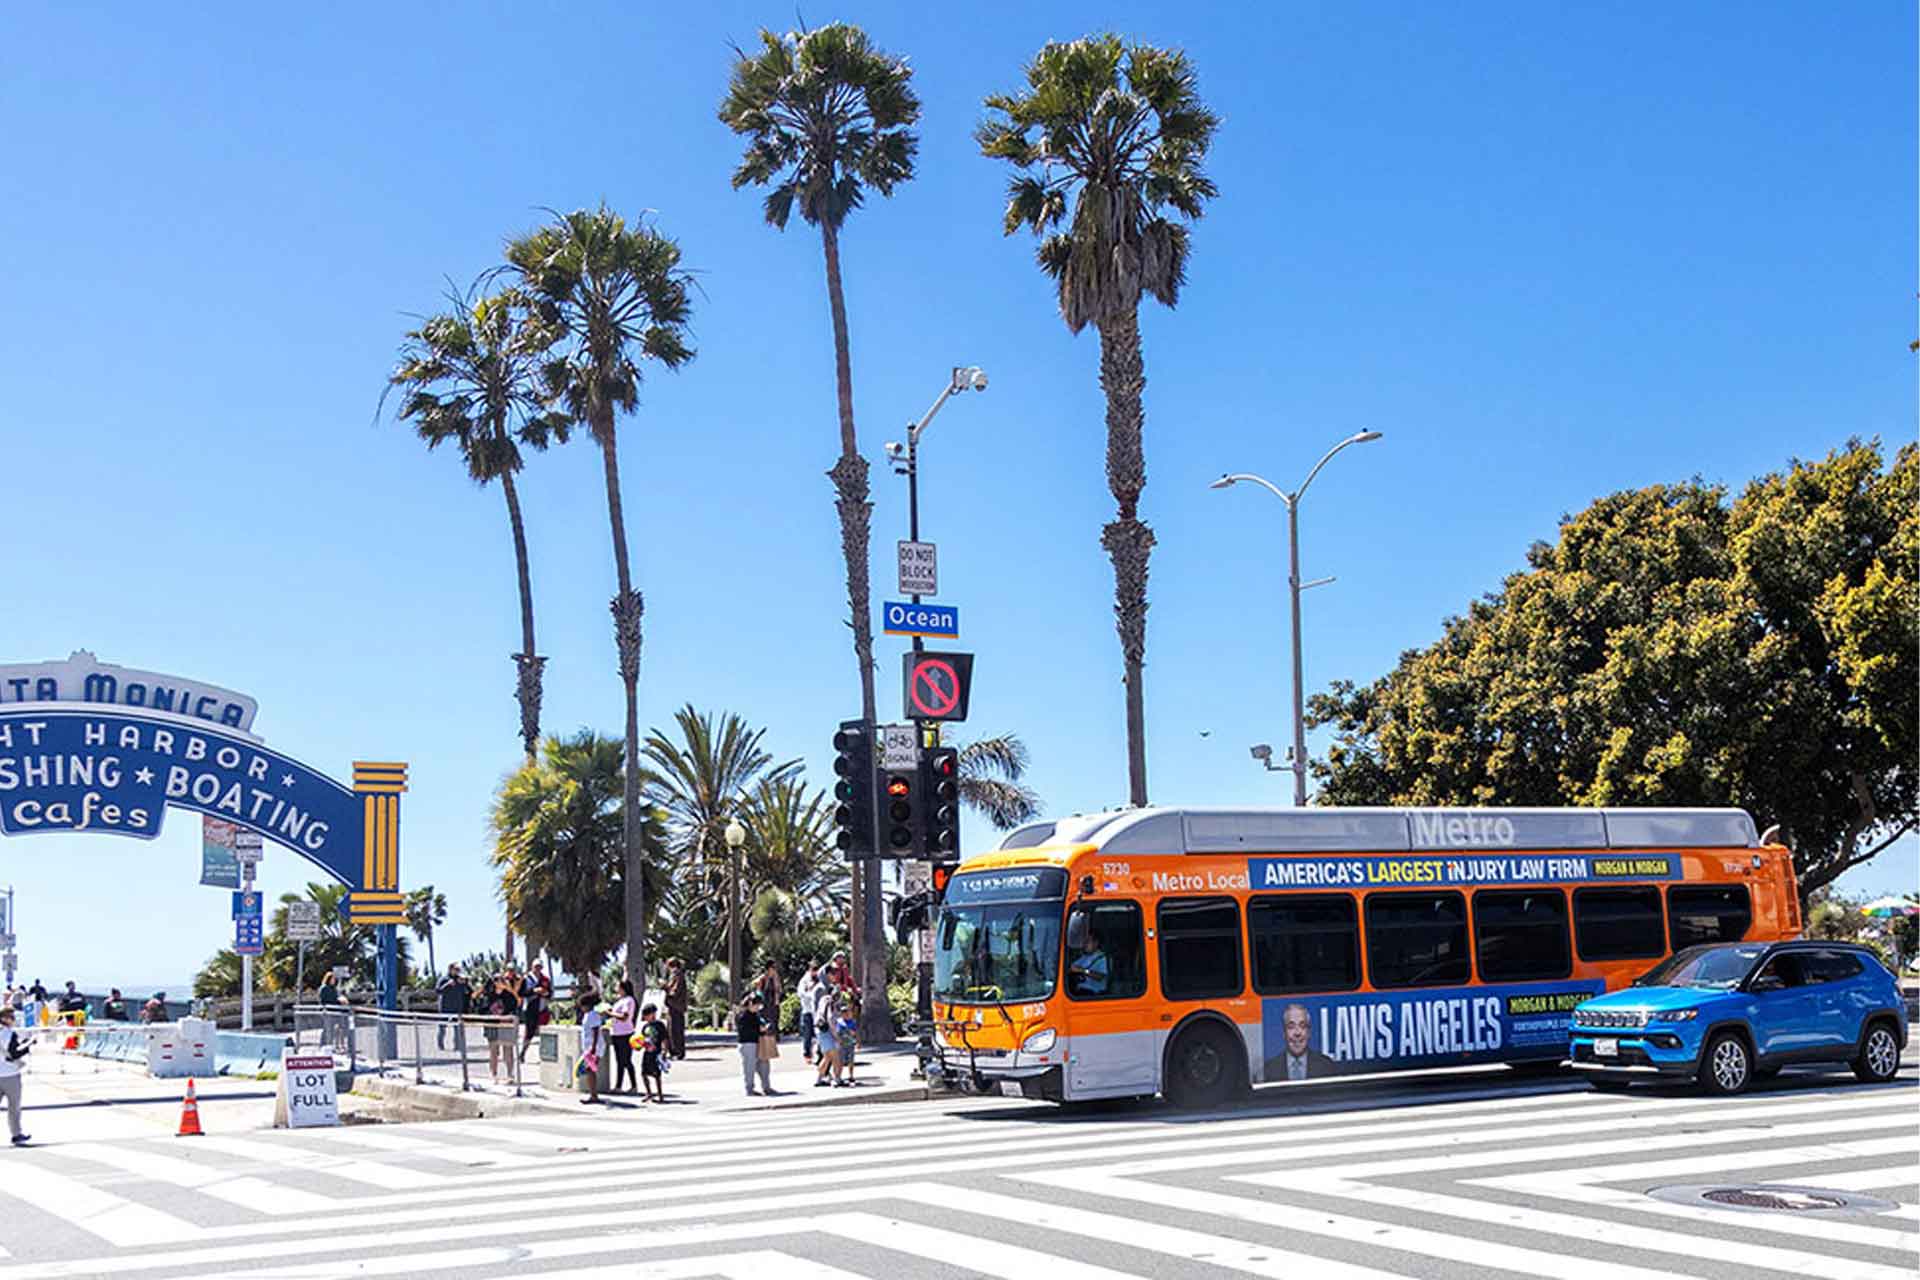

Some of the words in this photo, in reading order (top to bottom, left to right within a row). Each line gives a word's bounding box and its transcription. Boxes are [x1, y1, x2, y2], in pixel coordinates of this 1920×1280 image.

[901, 547, 914, 561] DO
[915, 549, 933, 562] NOT
[901, 564, 933, 578] BLOCK
[889, 606, 953, 628] Ocean
[0, 678, 57, 703] TA
[84, 672, 244, 729] MONICA
[85, 722, 269, 782] HARBOR
[0, 754, 121, 791] SHING
[165, 765, 330, 850] BOATING
[1414, 811, 1515, 847] Metro
[1264, 861, 1365, 886] AMERICA'S
[1367, 860, 1444, 883] LARGEST
[1447, 859, 1509, 881] INJURY
[1511, 858, 1545, 880] LAW
[1548, 858, 1588, 879] FIRM
[1594, 861, 1626, 875] MORGAN
[1636, 860, 1668, 875] MORGAN
[1152, 871, 1203, 891] Metro
[1207, 870, 1251, 890] Local
[1320, 1003, 1393, 1062] LAWS
[1400, 996, 1502, 1057] ANGELES
[296, 1073, 327, 1088] LOT
[293, 1093, 334, 1107] FULL
